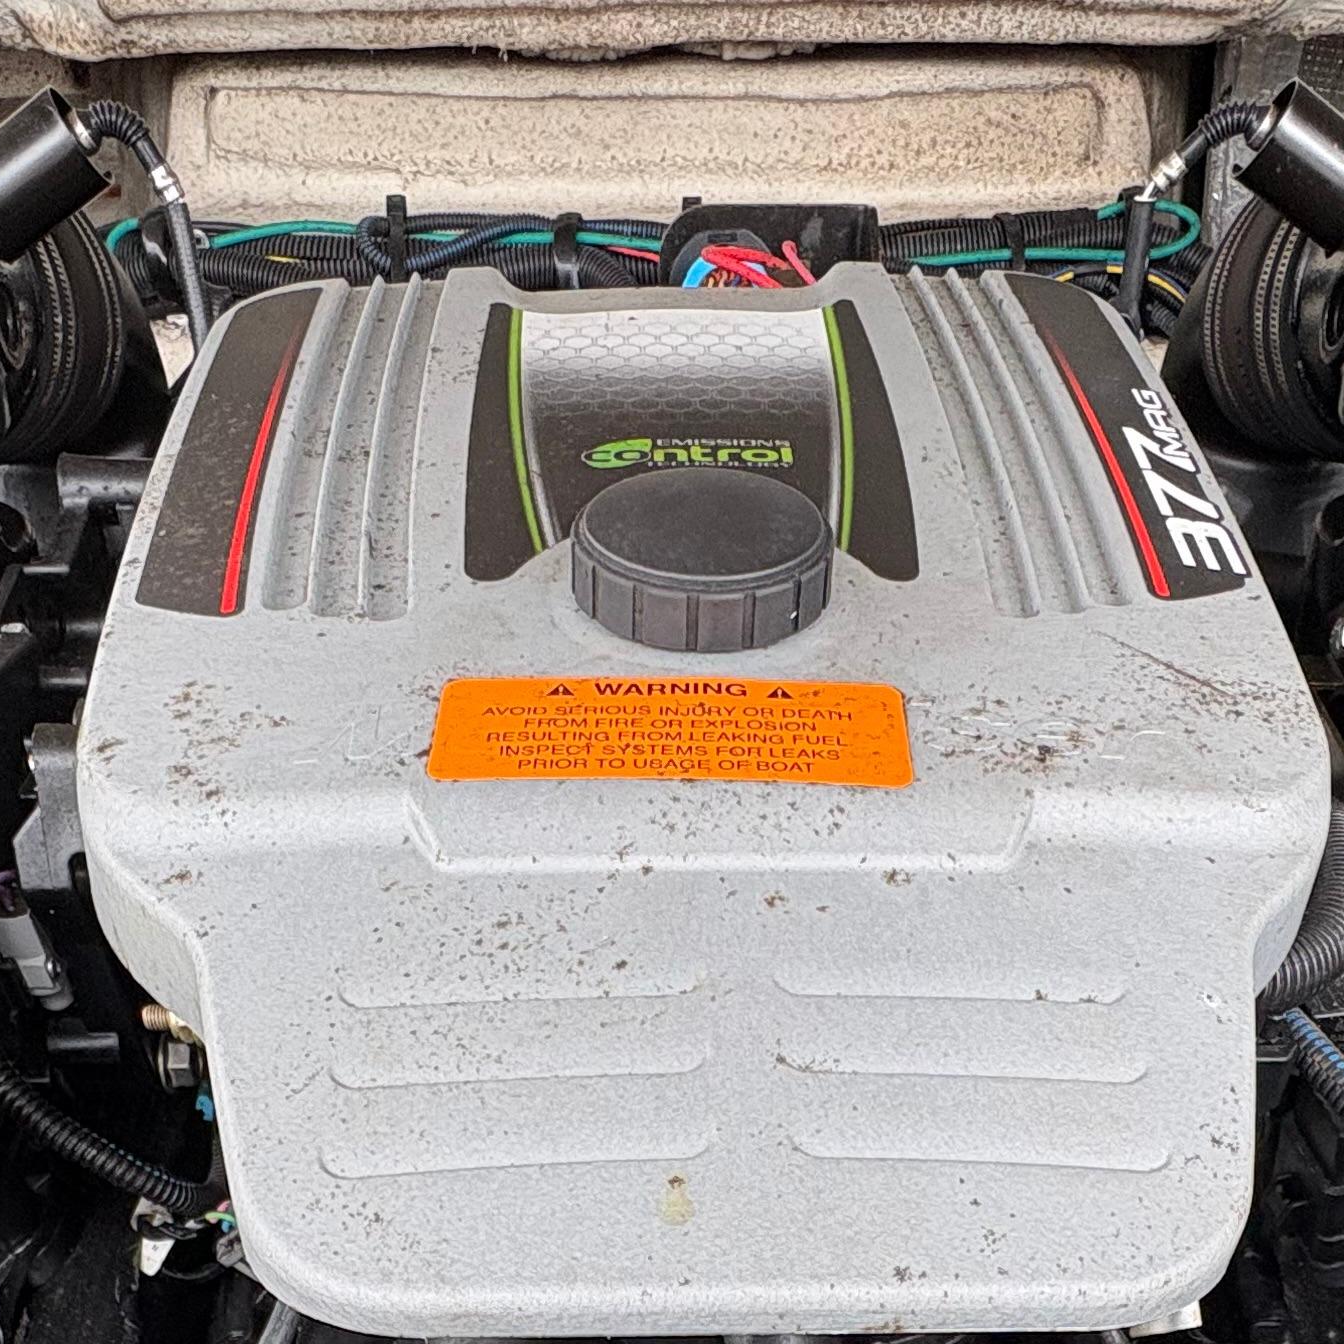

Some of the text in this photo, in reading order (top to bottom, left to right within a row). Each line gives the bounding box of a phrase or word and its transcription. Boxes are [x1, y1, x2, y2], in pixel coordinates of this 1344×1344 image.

[656, 438, 791, 448] EMISSIONS
[1121, 388, 1248, 576] 377 MAG
[594, 682, 747, 697] WARNING
[482, 705, 853, 721] AVOID SERIOUS INJURY OR DEATH
[524, 717, 817, 732] FROM FIRE OR EXPLOSION
[486, 731, 849, 747] RESULTING FROM LEAKING FUEL
[499, 743, 840, 761] INSPECT SYSTEMS FOR LEAKS
[517, 758, 815, 773] PRIOR TO USAGE OF BOAT
